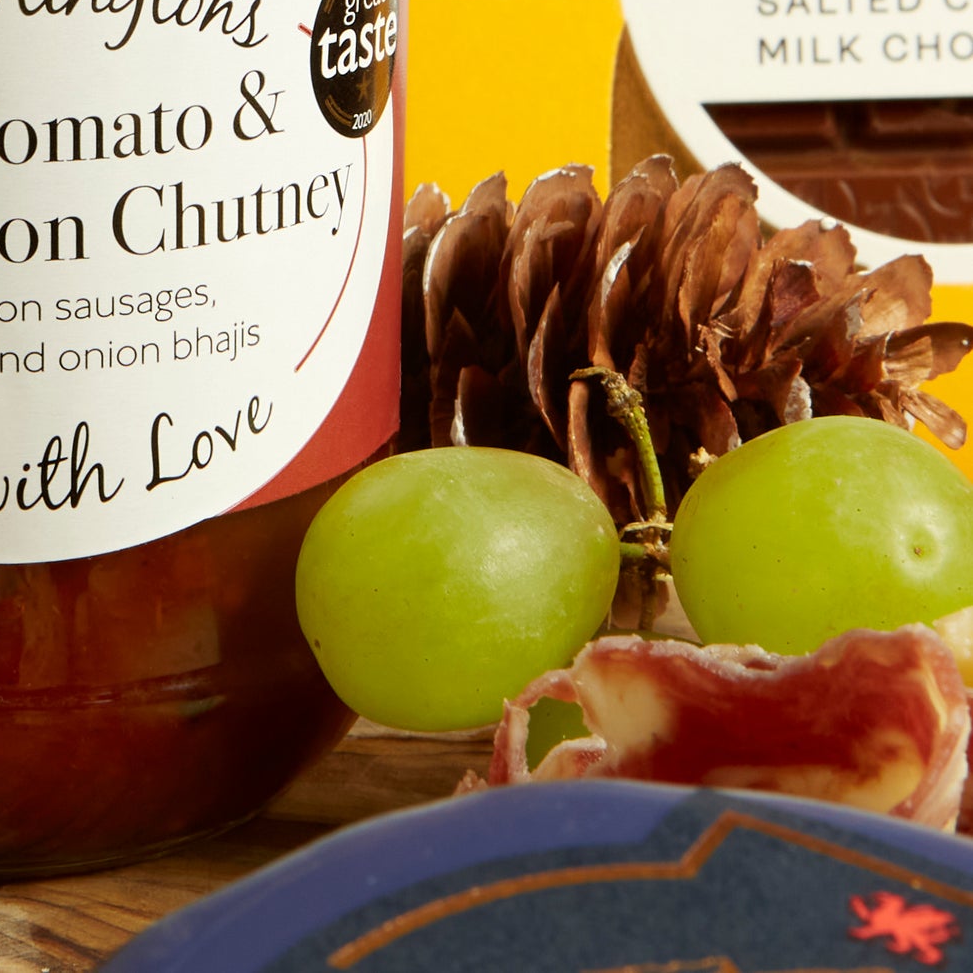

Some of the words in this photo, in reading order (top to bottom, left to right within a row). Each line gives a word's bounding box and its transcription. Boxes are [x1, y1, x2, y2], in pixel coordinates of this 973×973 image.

[317, 10, 398, 80] taste
[757, 33, 863, 66] MILK
[882, 31, 973, 63] CHO
[231, 69, 287, 142] &
[351, 108, 373, 131] 2020
[110, 161, 355, 257] Chutney
[55, 283, 217, 323] sausages,
[58, 340, 160, 372] onion
[173, 320, 261, 362] bhajis
[144, 395, 274, 492] Love
